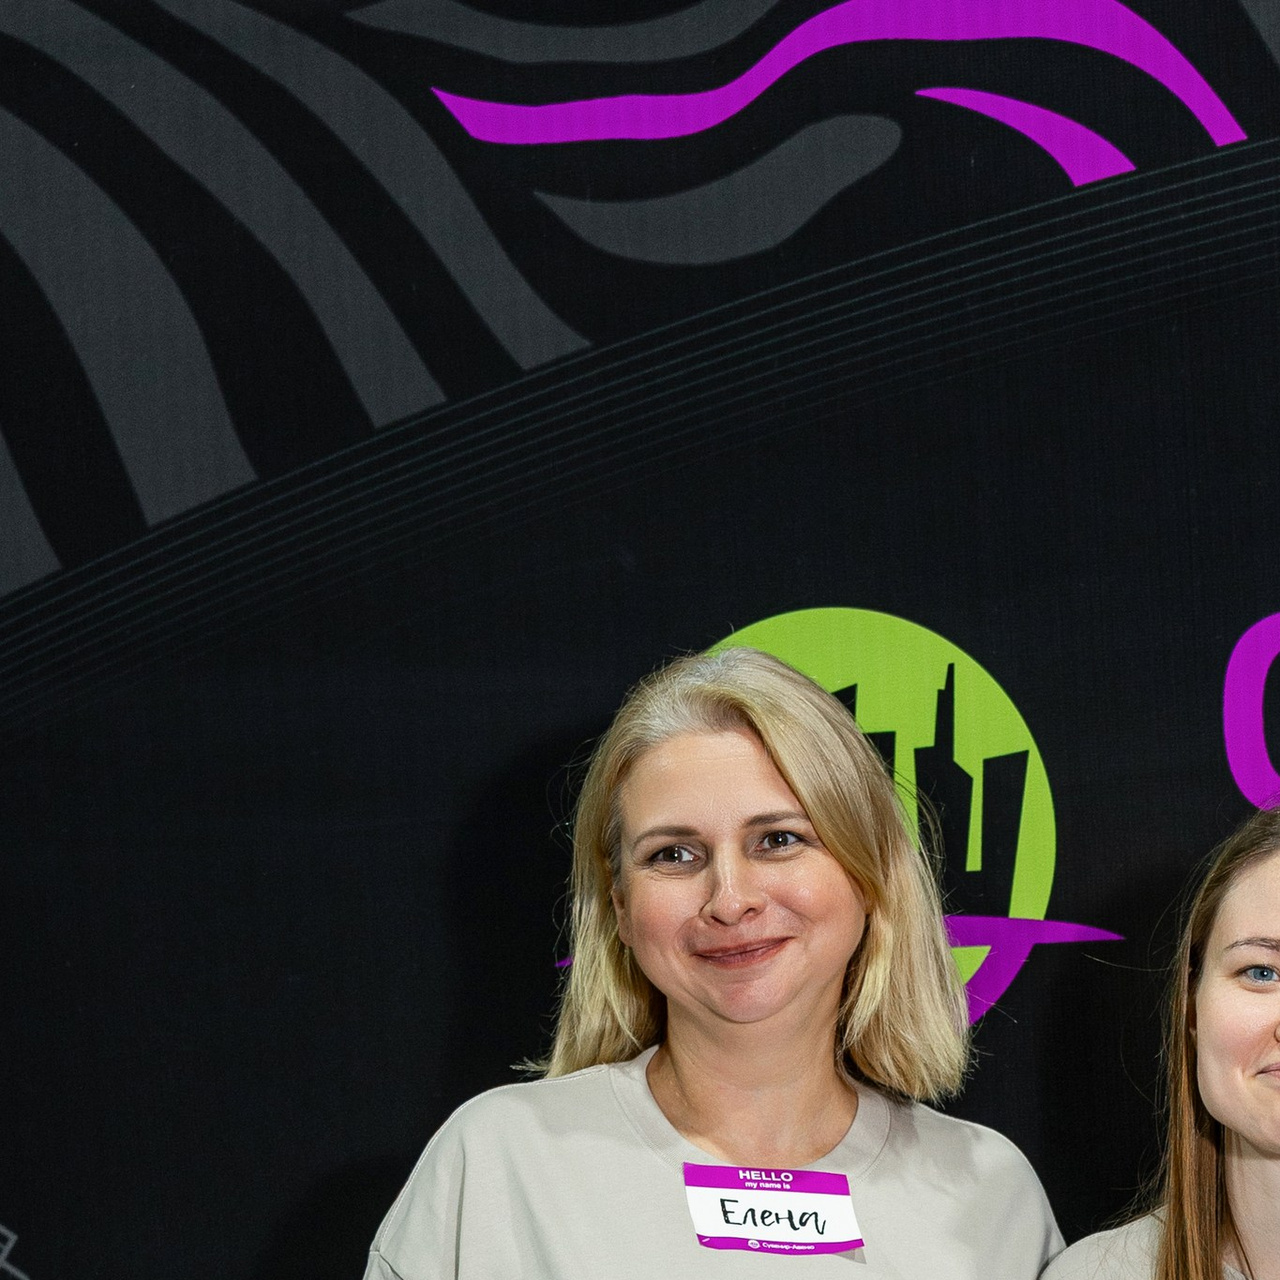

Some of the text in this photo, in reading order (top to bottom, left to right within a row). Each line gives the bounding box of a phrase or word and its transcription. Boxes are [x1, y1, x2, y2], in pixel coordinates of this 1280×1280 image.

[738, 1169, 794, 1182] HELLO
[744, 1181, 758, 1189] my
[782, 1182, 791, 1190] is
[719, 1198, 826, 1236] Елена
